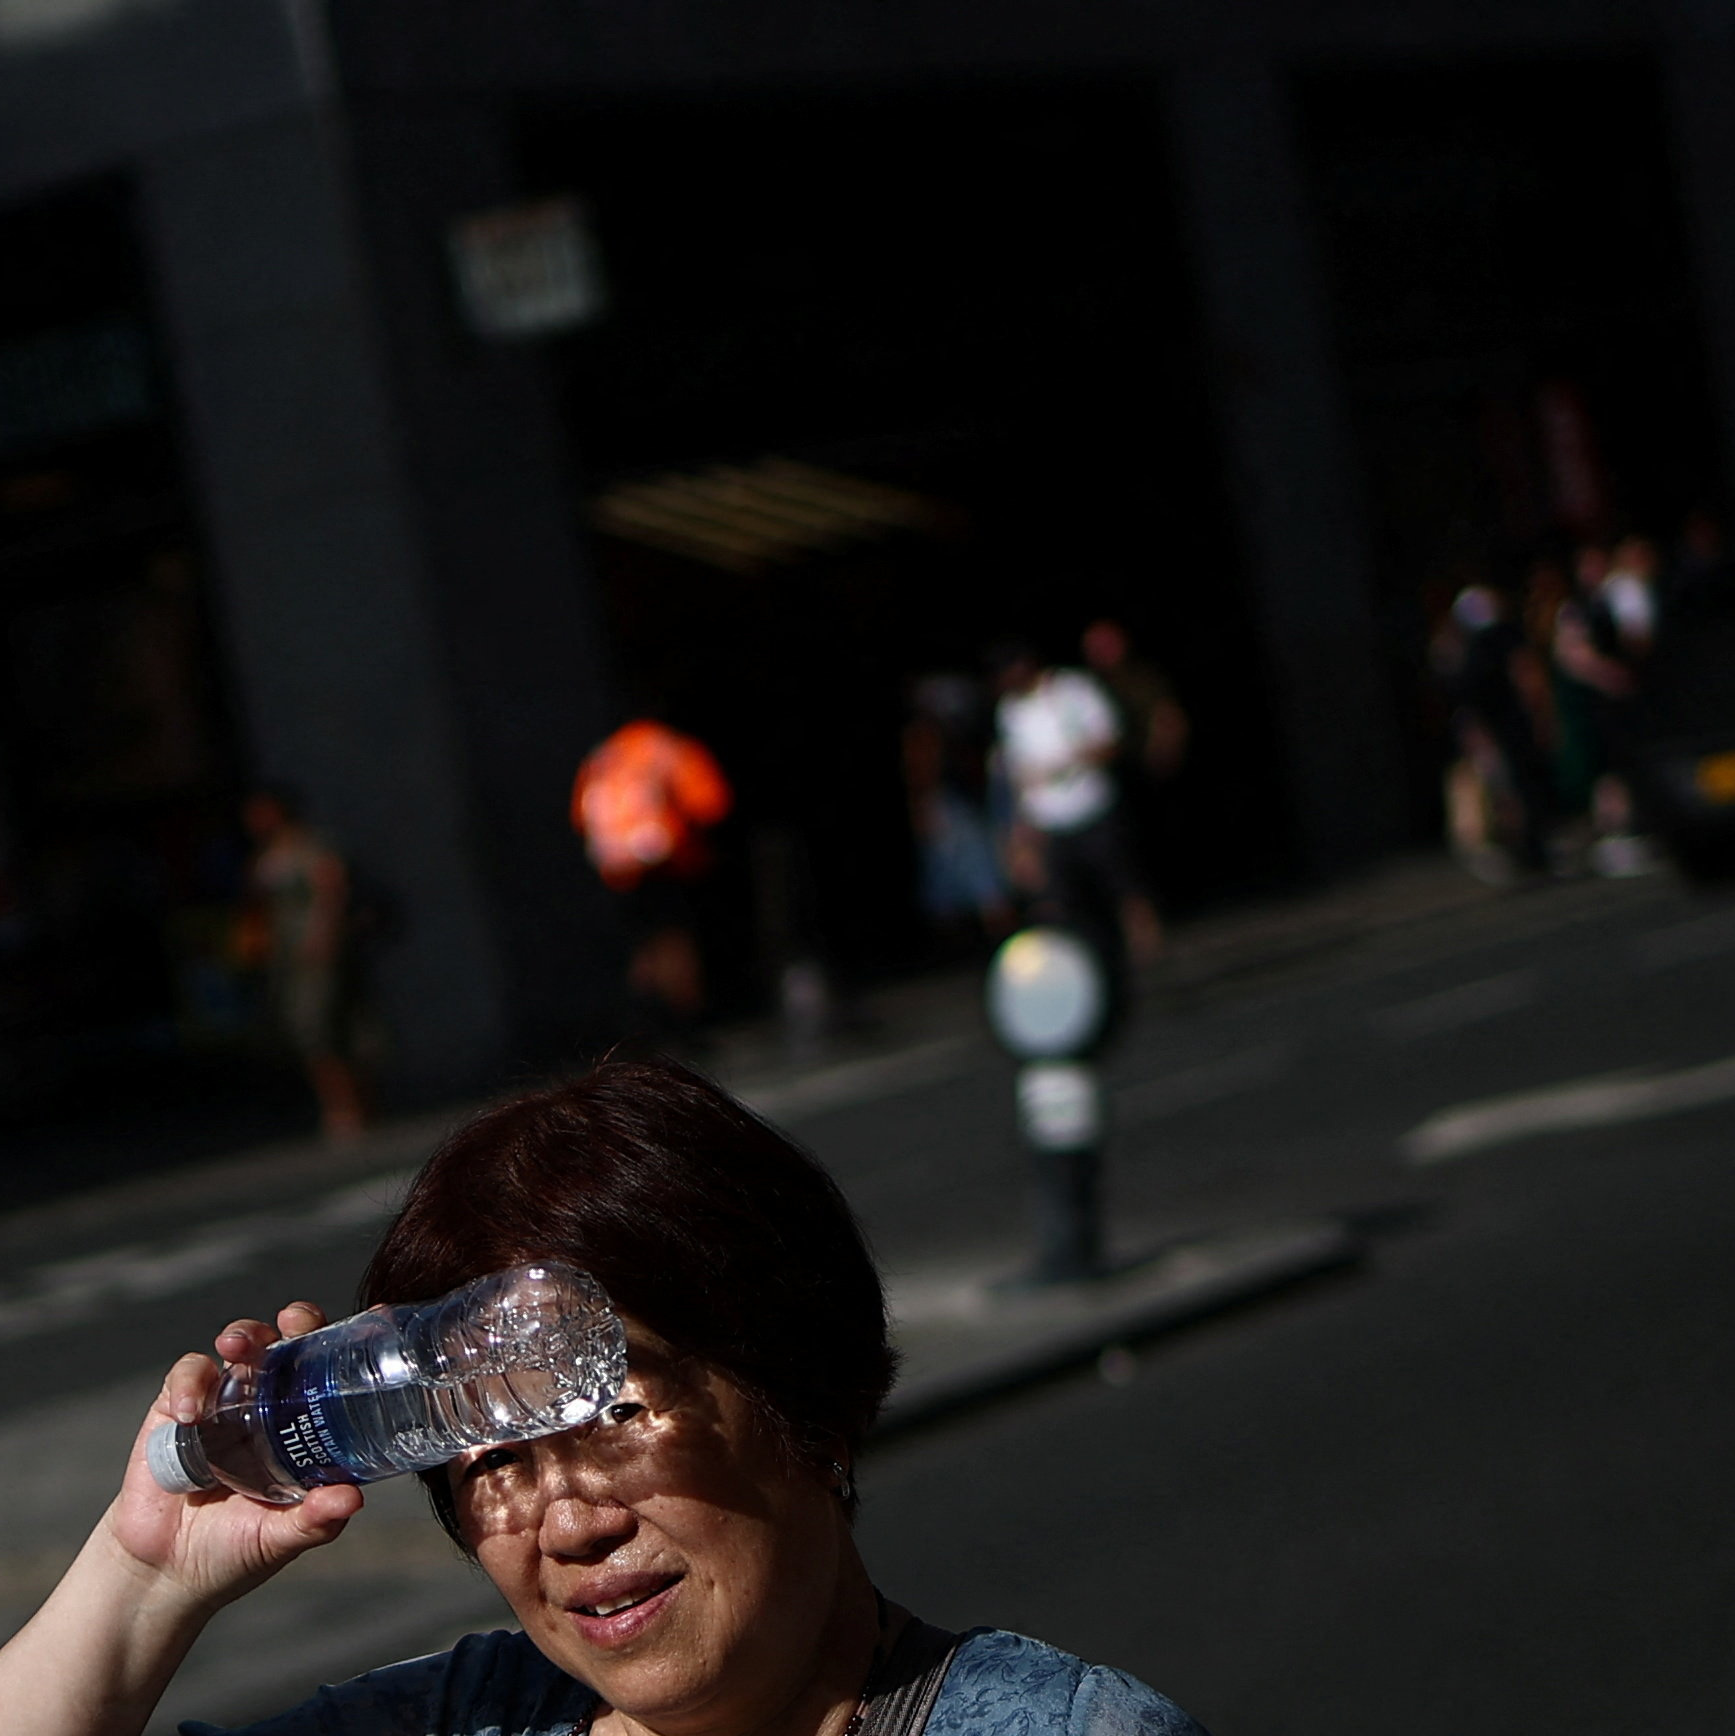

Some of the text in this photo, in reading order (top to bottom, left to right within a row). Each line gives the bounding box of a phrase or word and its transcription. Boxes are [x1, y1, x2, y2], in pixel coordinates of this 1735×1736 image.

[305, 1386, 326, 1428] WATER
[279, 1421, 314, 1468] STILL
[297, 1413, 332, 1465] SCOTTISH
